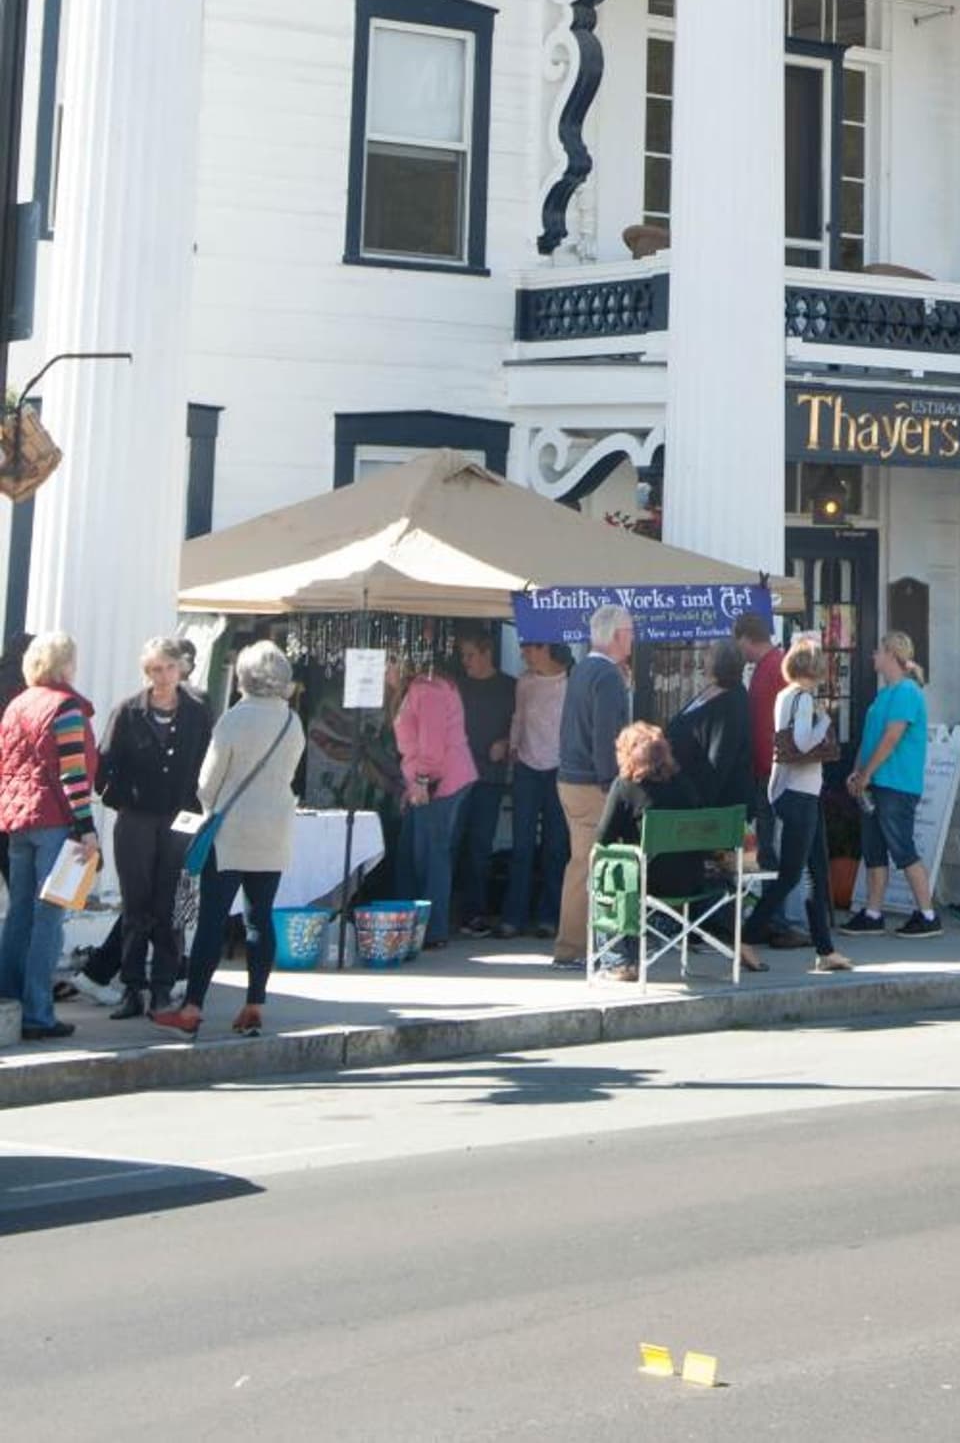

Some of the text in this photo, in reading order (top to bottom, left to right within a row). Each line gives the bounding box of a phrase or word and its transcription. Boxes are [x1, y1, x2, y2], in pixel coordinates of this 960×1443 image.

[797, 394, 960, 459] Thayers
[615, 588, 676, 609] Works
[681, 587, 715, 608] and
[719, 586, 753, 620] Art
